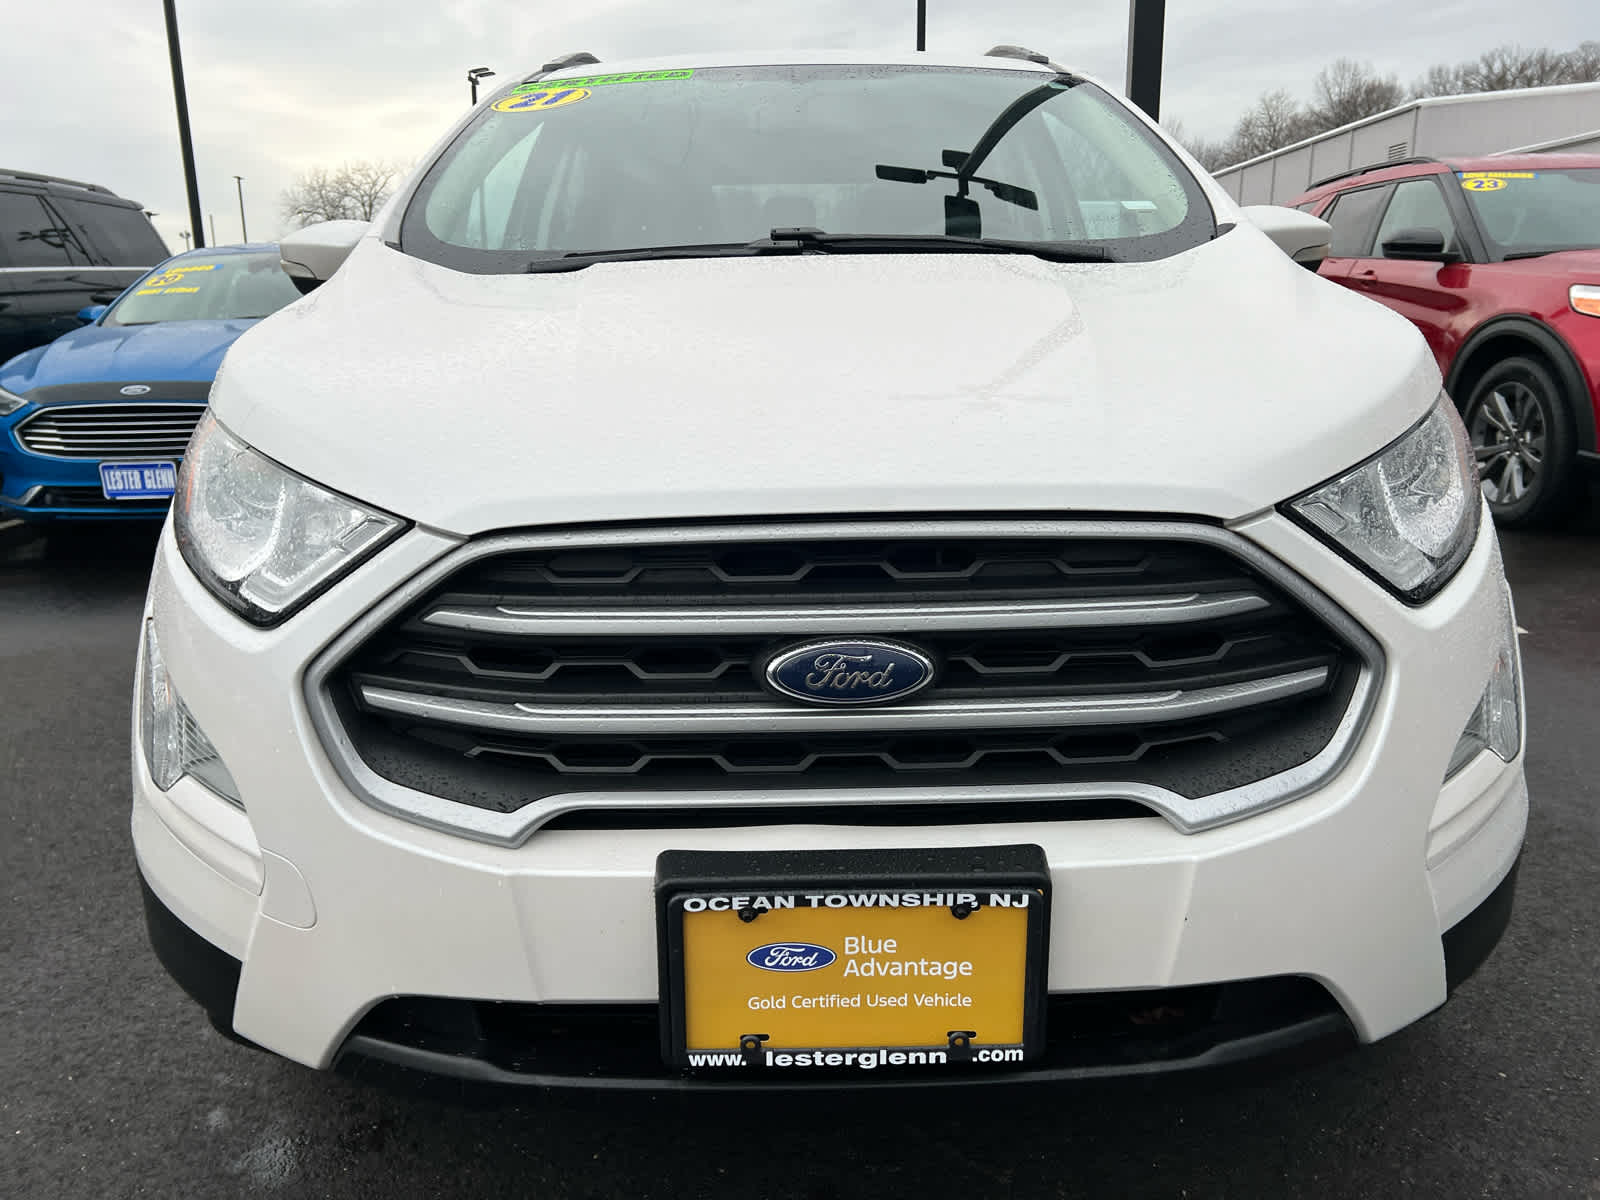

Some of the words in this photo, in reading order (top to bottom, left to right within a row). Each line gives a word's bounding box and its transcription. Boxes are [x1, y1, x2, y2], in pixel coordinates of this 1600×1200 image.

[508, 89, 577, 109] 21
[1473, 179, 1499, 189] 23
[104, 469, 142, 490] LESTER
[143, 468, 175, 489] GLENN
[805, 653, 895, 689] Ford
[683, 895, 794, 912] OCEAN
[805, 893, 978, 909] TOWNSHIP,
[990, 893, 1029, 908] NJ
[844, 936, 897, 955] Blue
[764, 946, 818, 968] Ford
[843, 956, 973, 980] Advantage
[747, 995, 786, 1010] Gold
[791, 994, 861, 1009] Certified
[866, 993, 908, 1008] Used
[913, 992, 972, 1008] Vehicle
[688, 1052, 747, 1067] www.
[765, 1048, 947, 1069] lesterglenn
[971, 1047, 1024, 1062] .com
